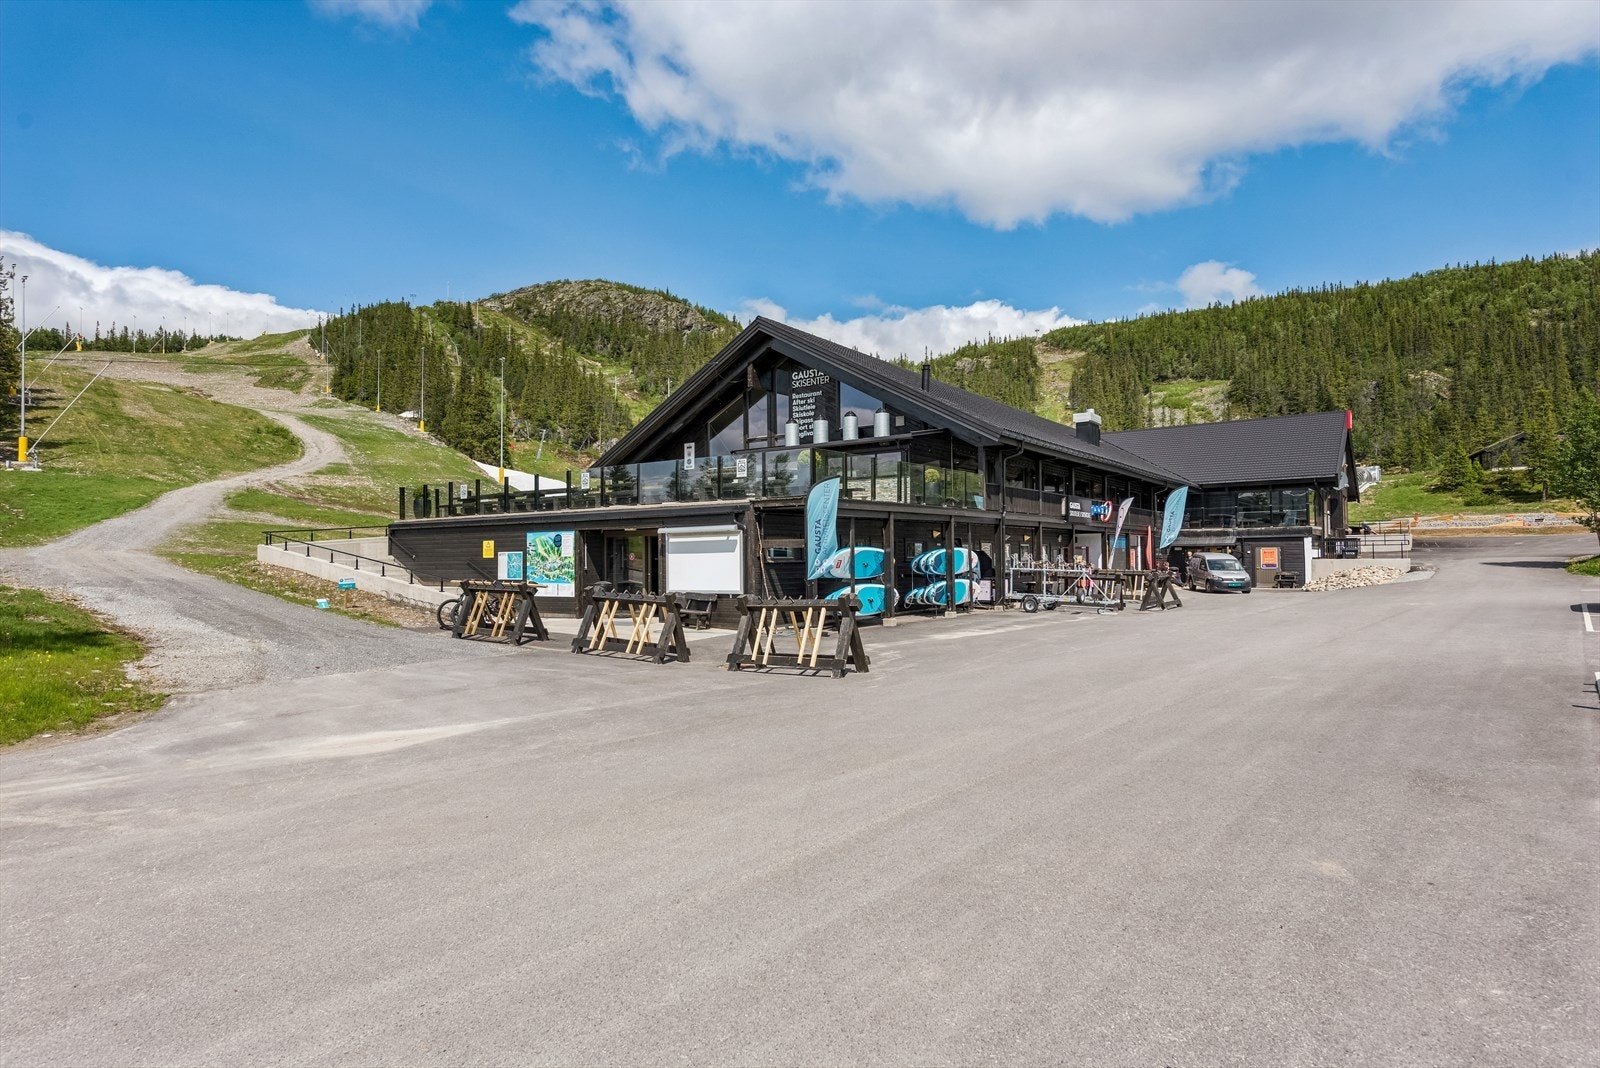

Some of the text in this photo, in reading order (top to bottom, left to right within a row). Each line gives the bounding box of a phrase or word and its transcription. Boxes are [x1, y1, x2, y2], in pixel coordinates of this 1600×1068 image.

[792, 376, 830, 388] SKISENTER
[792, 390, 822, 399] Restaurant
[814, 518, 822, 555] GAUSTA
